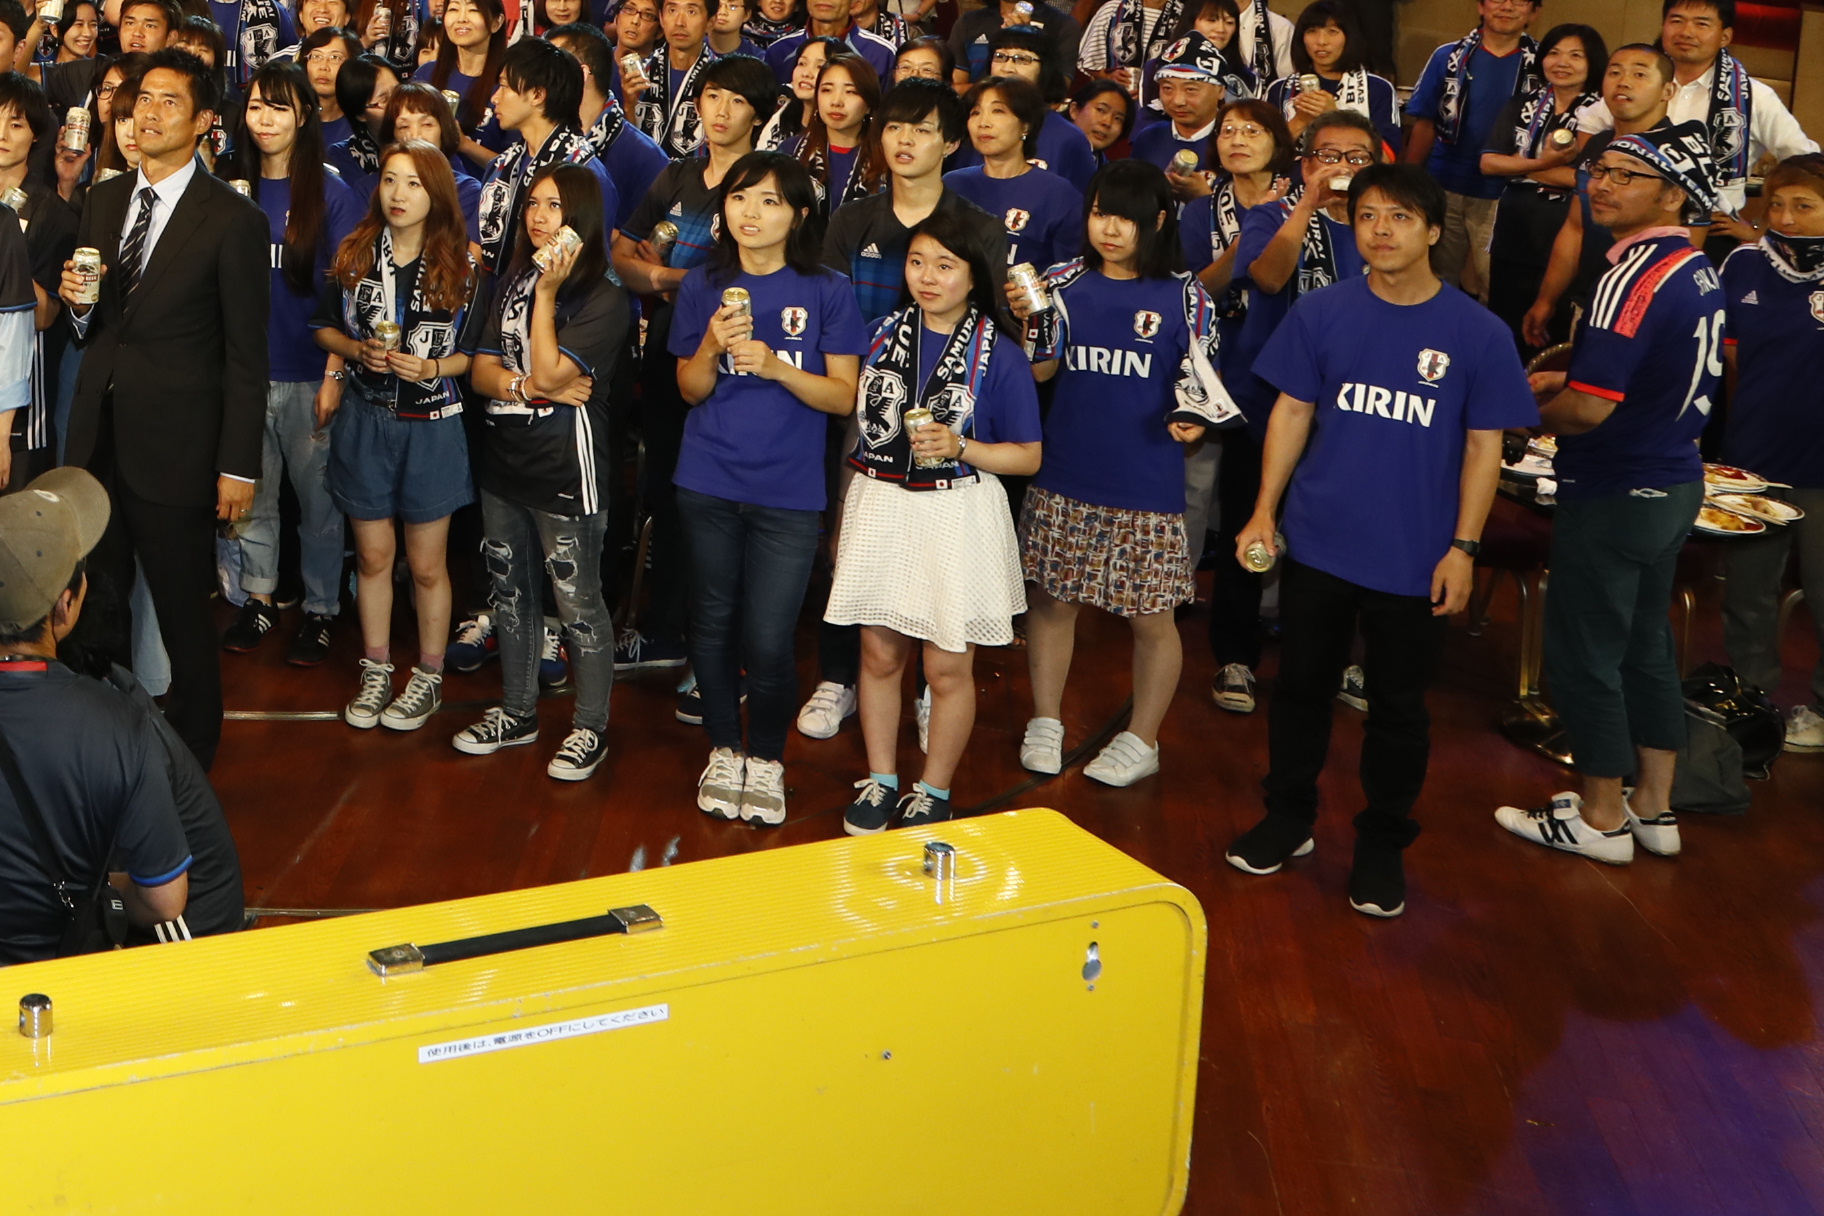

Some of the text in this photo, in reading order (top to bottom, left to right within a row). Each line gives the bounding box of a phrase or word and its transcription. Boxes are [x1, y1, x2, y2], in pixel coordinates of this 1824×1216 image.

[1679, 173, 1714, 210] TEAM
[358, 286, 383, 304] FA
[1186, 284, 1199, 326] EAM
[891, 306, 915, 369] LUE
[977, 317, 996, 377] JAPAN
[415, 390, 452, 406] JAPAN
[1336, 382, 1437, 428] KIRIN
[426, 1006, 666, 1059] 使用後は、電源をOFFにしてください
